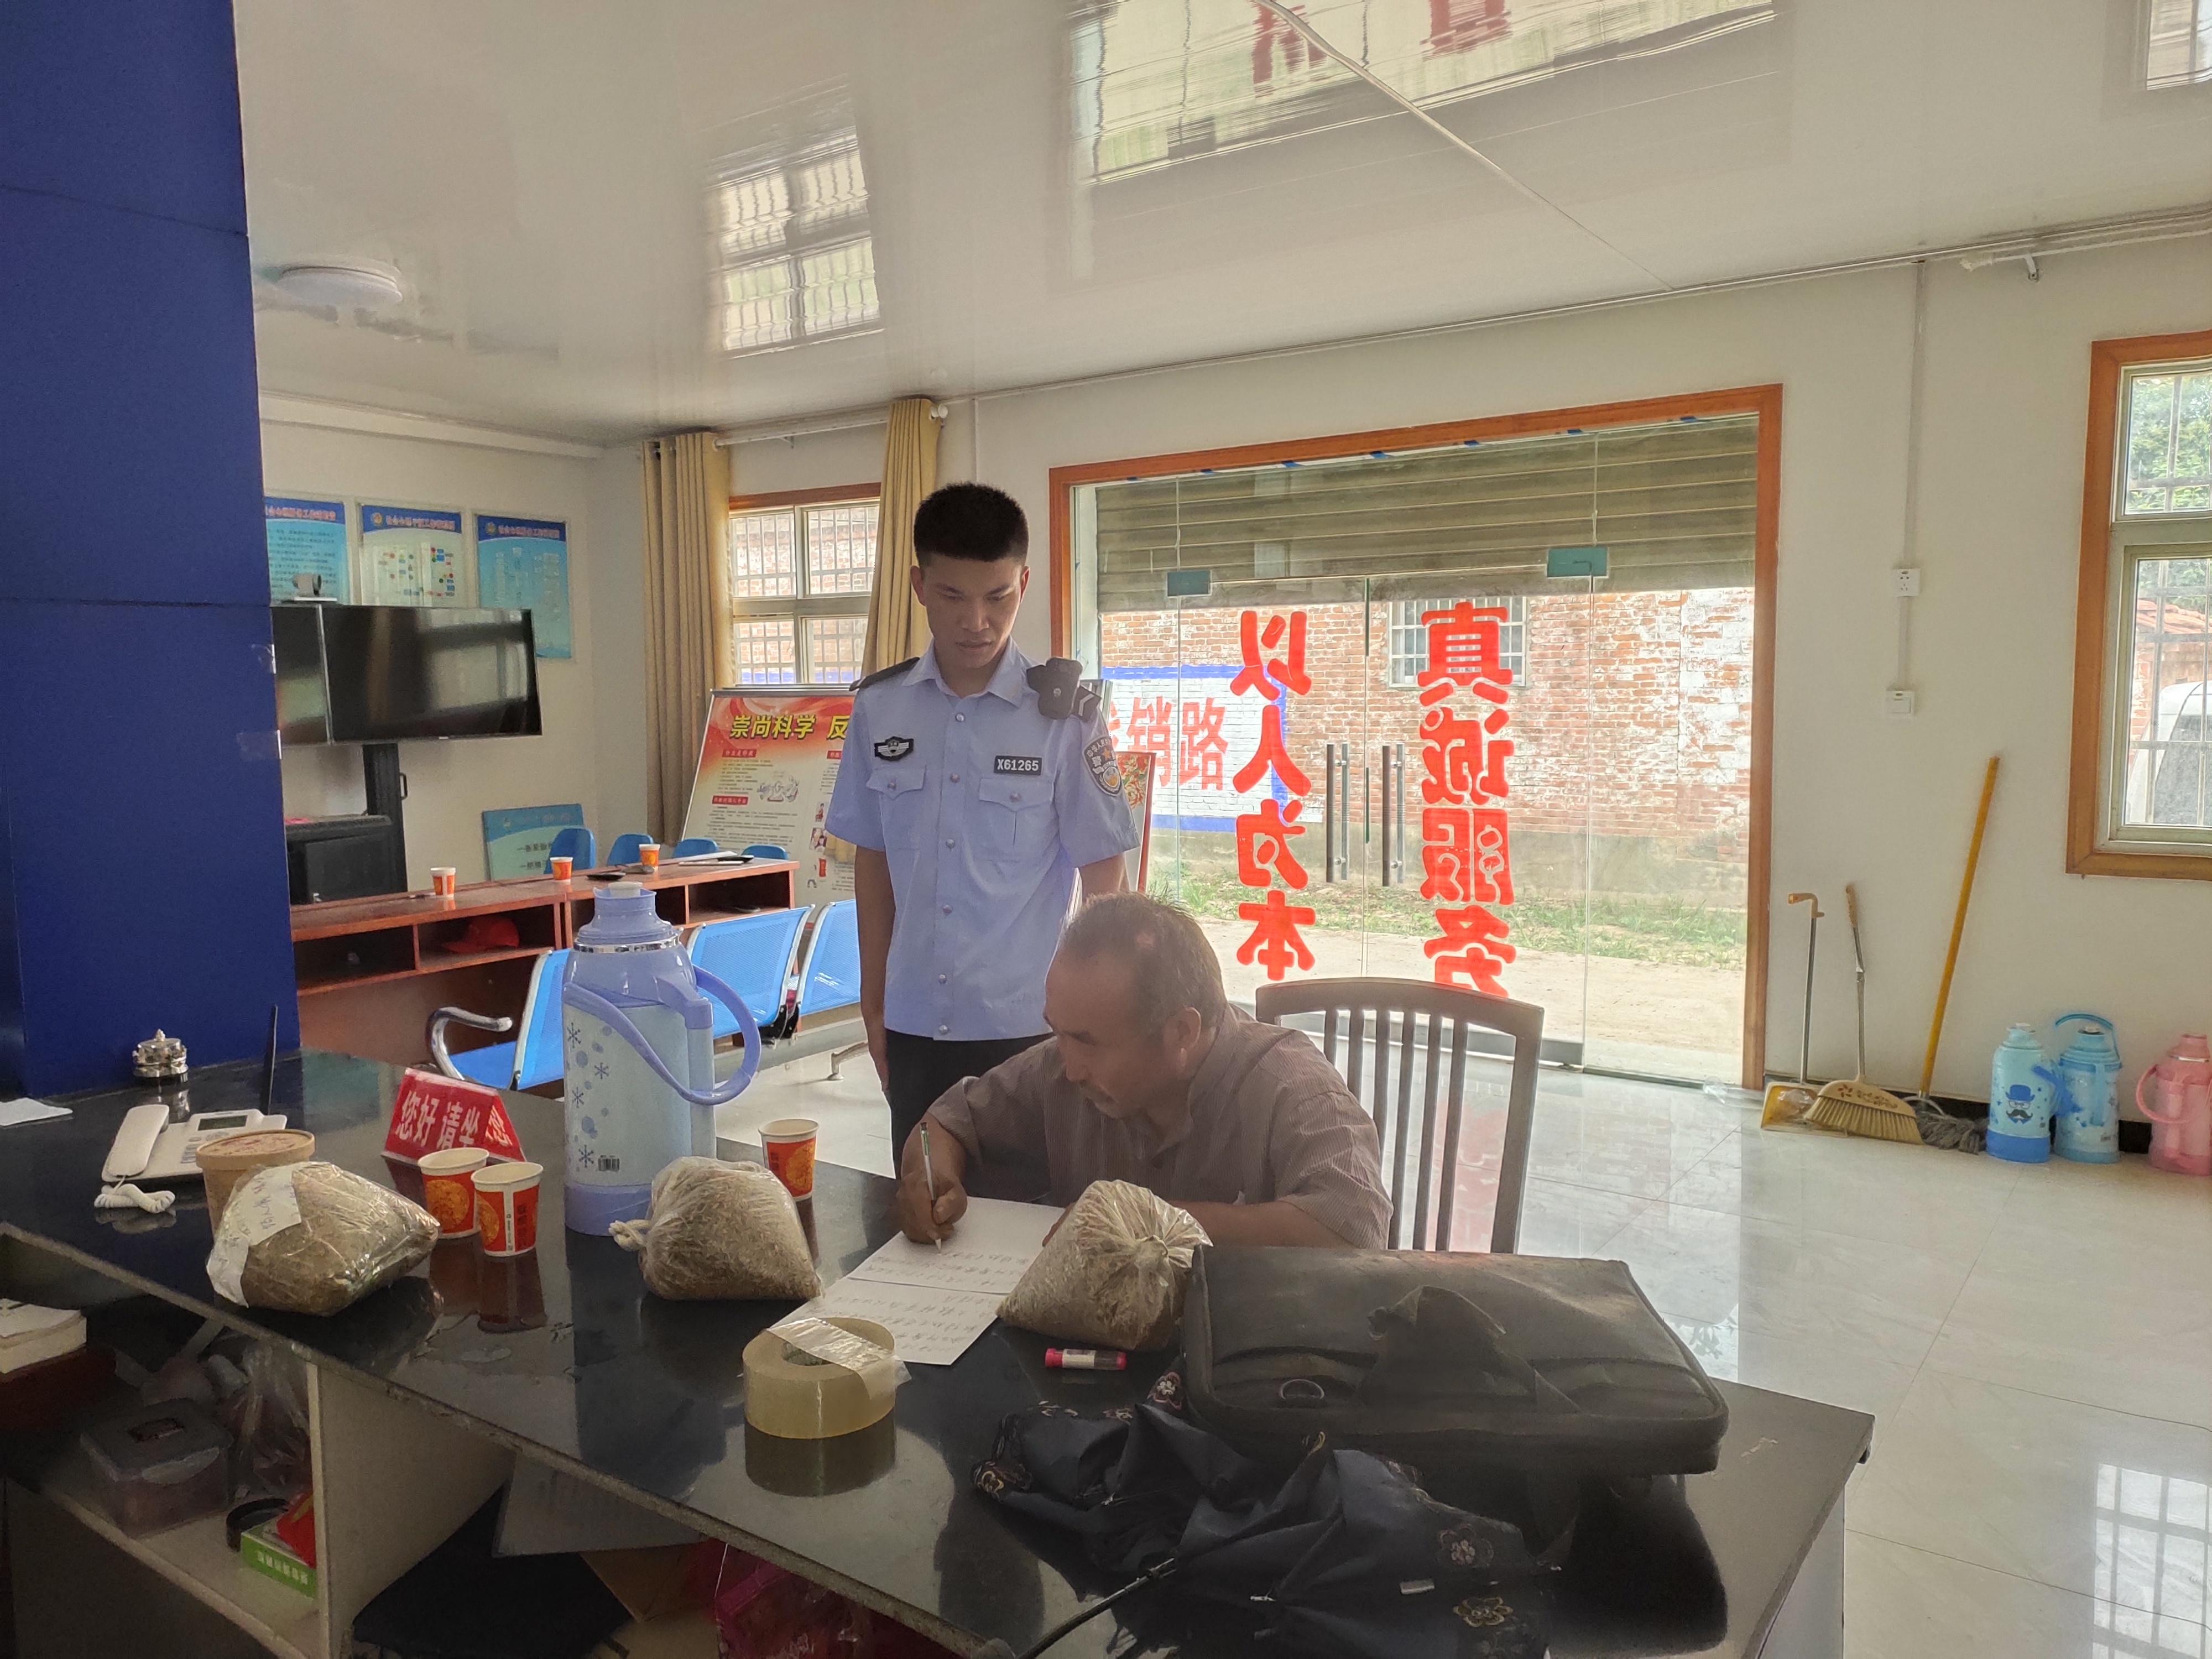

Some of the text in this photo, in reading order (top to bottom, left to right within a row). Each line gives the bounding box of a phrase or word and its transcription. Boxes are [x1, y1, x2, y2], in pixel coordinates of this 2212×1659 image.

[729, 714, 851, 740] 崇尚科学 反
[1108, 696, 1228, 791] 销路
[997, 758, 1039, 771] X61265
